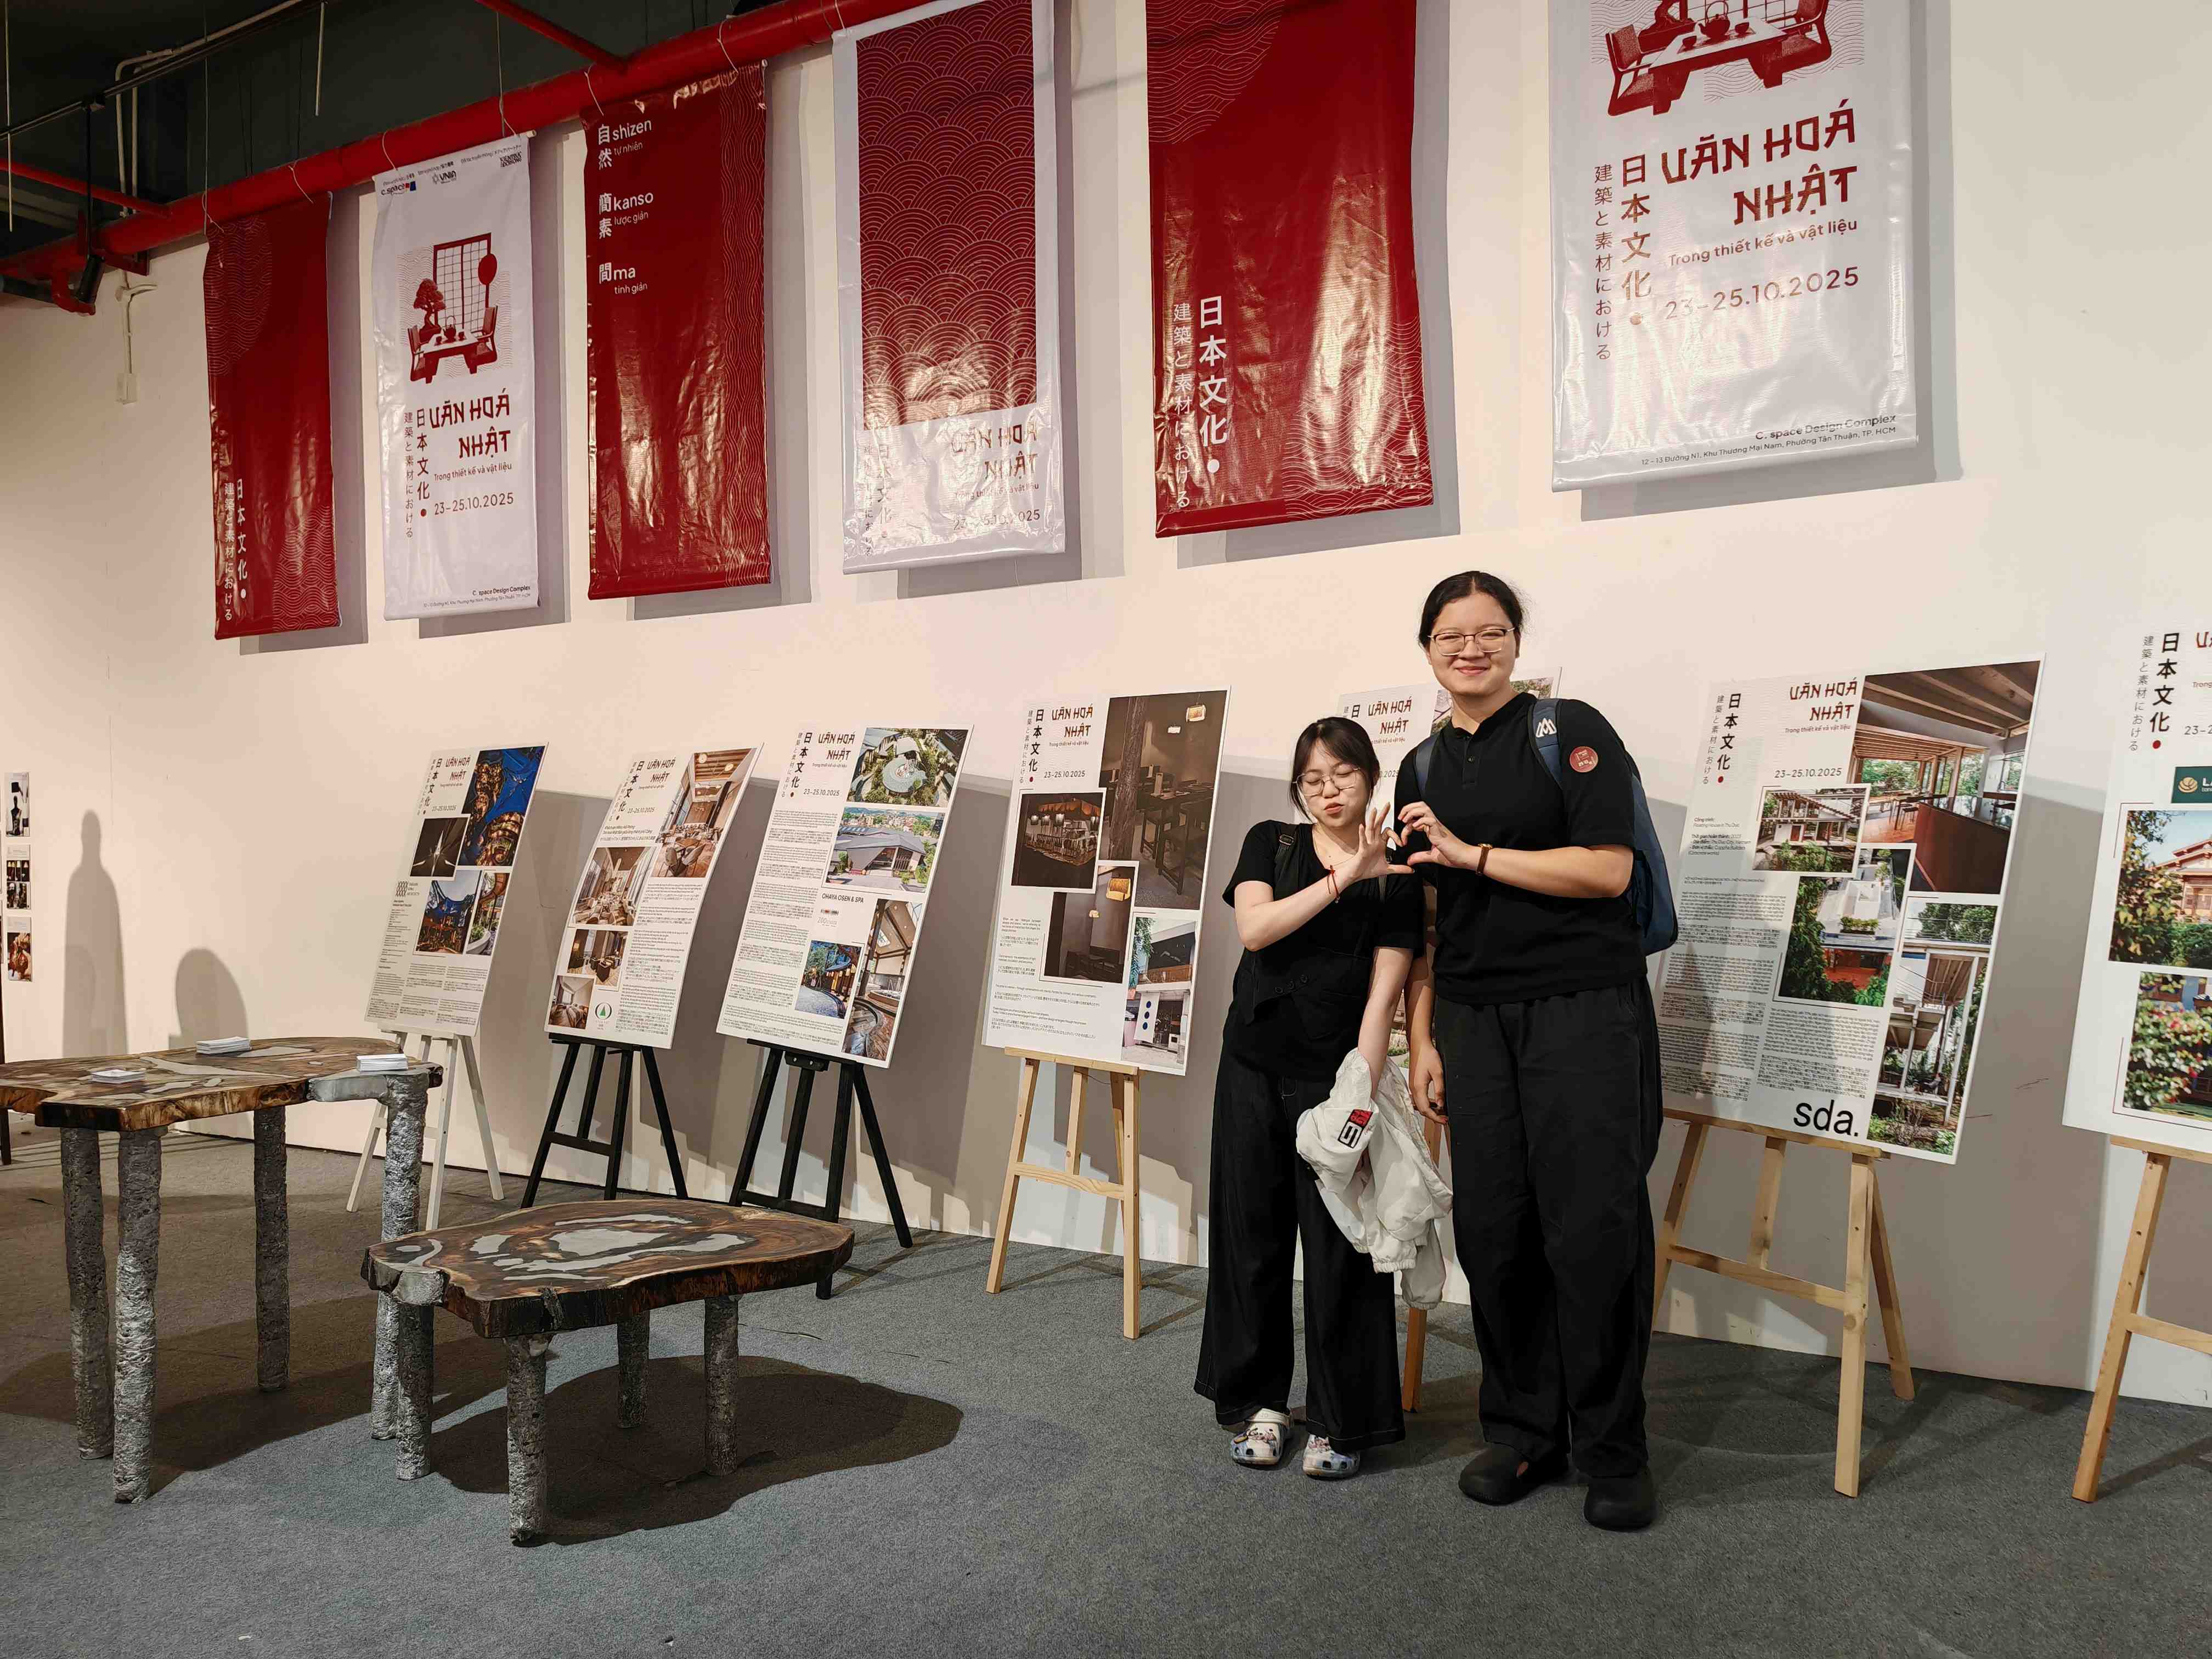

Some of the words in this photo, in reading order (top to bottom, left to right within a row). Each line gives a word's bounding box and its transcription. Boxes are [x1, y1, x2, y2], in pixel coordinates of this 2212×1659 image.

[612, 120, 652, 141] shizen
[1764, 98, 1855, 162] HOÁ
[598, 124, 612, 170] 自然
[614, 146, 622, 157] tự
[622, 141, 643, 154] nhiên
[613, 192, 654, 212] kanso
[1734, 163, 1858, 225] NHẬT
[599, 193, 612, 239] 簡素
[614, 216, 632, 226] lược
[633, 210, 649, 224] giản
[1621, 154, 1651, 301] 日本文化
[1668, 249, 1711, 267] Trong
[1714, 237, 1751, 256] thiết
[1754, 233, 1774, 250] kế
[1778, 229, 1795, 245] và
[1799, 224, 1824, 241] vật
[1827, 219, 1858, 235] liệu
[599, 262, 612, 284] 間
[614, 267, 636, 281] ma
[1595, 164, 1613, 360] 建築と素材における
[631, 281, 648, 295] giản
[1199, 295, 1228, 447] 日本文化
[470, 387, 510, 419] HOÁ
[1173, 302, 1193, 507] 建築と素材における
[458, 426, 511, 459] NHẬT
[1769, 428, 1803, 439] space
[1805, 422, 1843, 434] Design
[1845, 414, 1896, 428] Complex
[416, 408, 430, 501] 日本文化
[1665, 453, 1690, 463] Đường
[1818, 435, 1832, 443] Tân
[1876, 426, 1896, 435] HCM
[404, 412, 414, 538] 建築と素材における
[434, 473, 451, 482] Trong
[452, 467, 467, 479] thiết
[467, 465, 476, 476] kế
[477, 465, 486, 474] và
[487, 462, 498, 474] vật
[499, 462, 512, 472] liệu
[985, 450, 1038, 479] NHẬT
[1825, 677, 1858, 698] HOÁ
[2149, 632, 2180, 733] 日本文化
[1073, 703, 1093, 719] HOÁ
[1390, 696, 1413, 714] HOÁ
[1809, 701, 1854, 723] NHẬT
[837, 730, 856, 744] HOÁ
[1028, 709, 1045, 772] 日本文化
[1064, 722, 1091, 740] NHẬT
[1379, 716, 1409, 736] NHẬT
[1717, 693, 1741, 771] 日本文化
[791, 732, 812, 788] 日本文化
[826, 747, 851, 763] NHẬT
[1793, 1099, 1859, 1137] sda.
